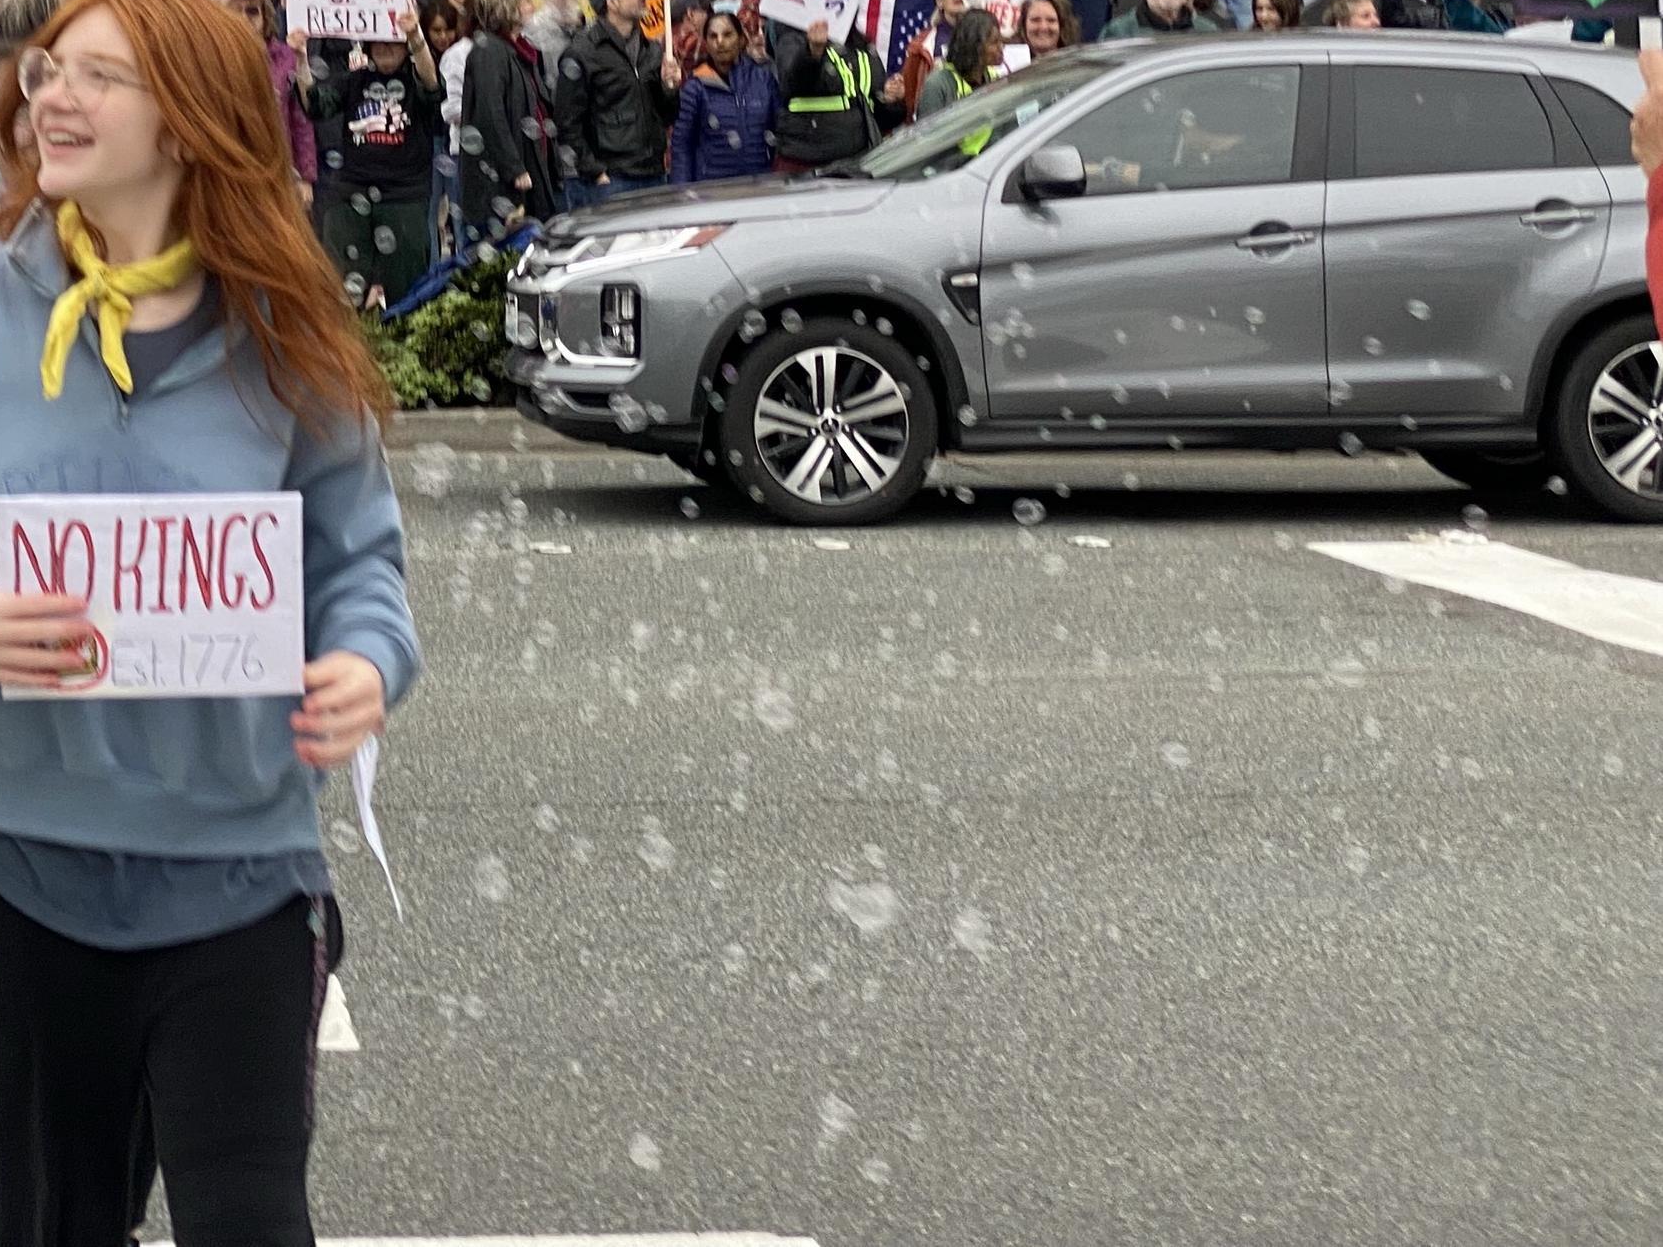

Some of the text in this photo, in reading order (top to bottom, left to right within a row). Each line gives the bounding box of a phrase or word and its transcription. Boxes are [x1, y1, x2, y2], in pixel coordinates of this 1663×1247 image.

[12, 510, 280, 613] NO KINGS
[179, 634, 265, 688] 1776
